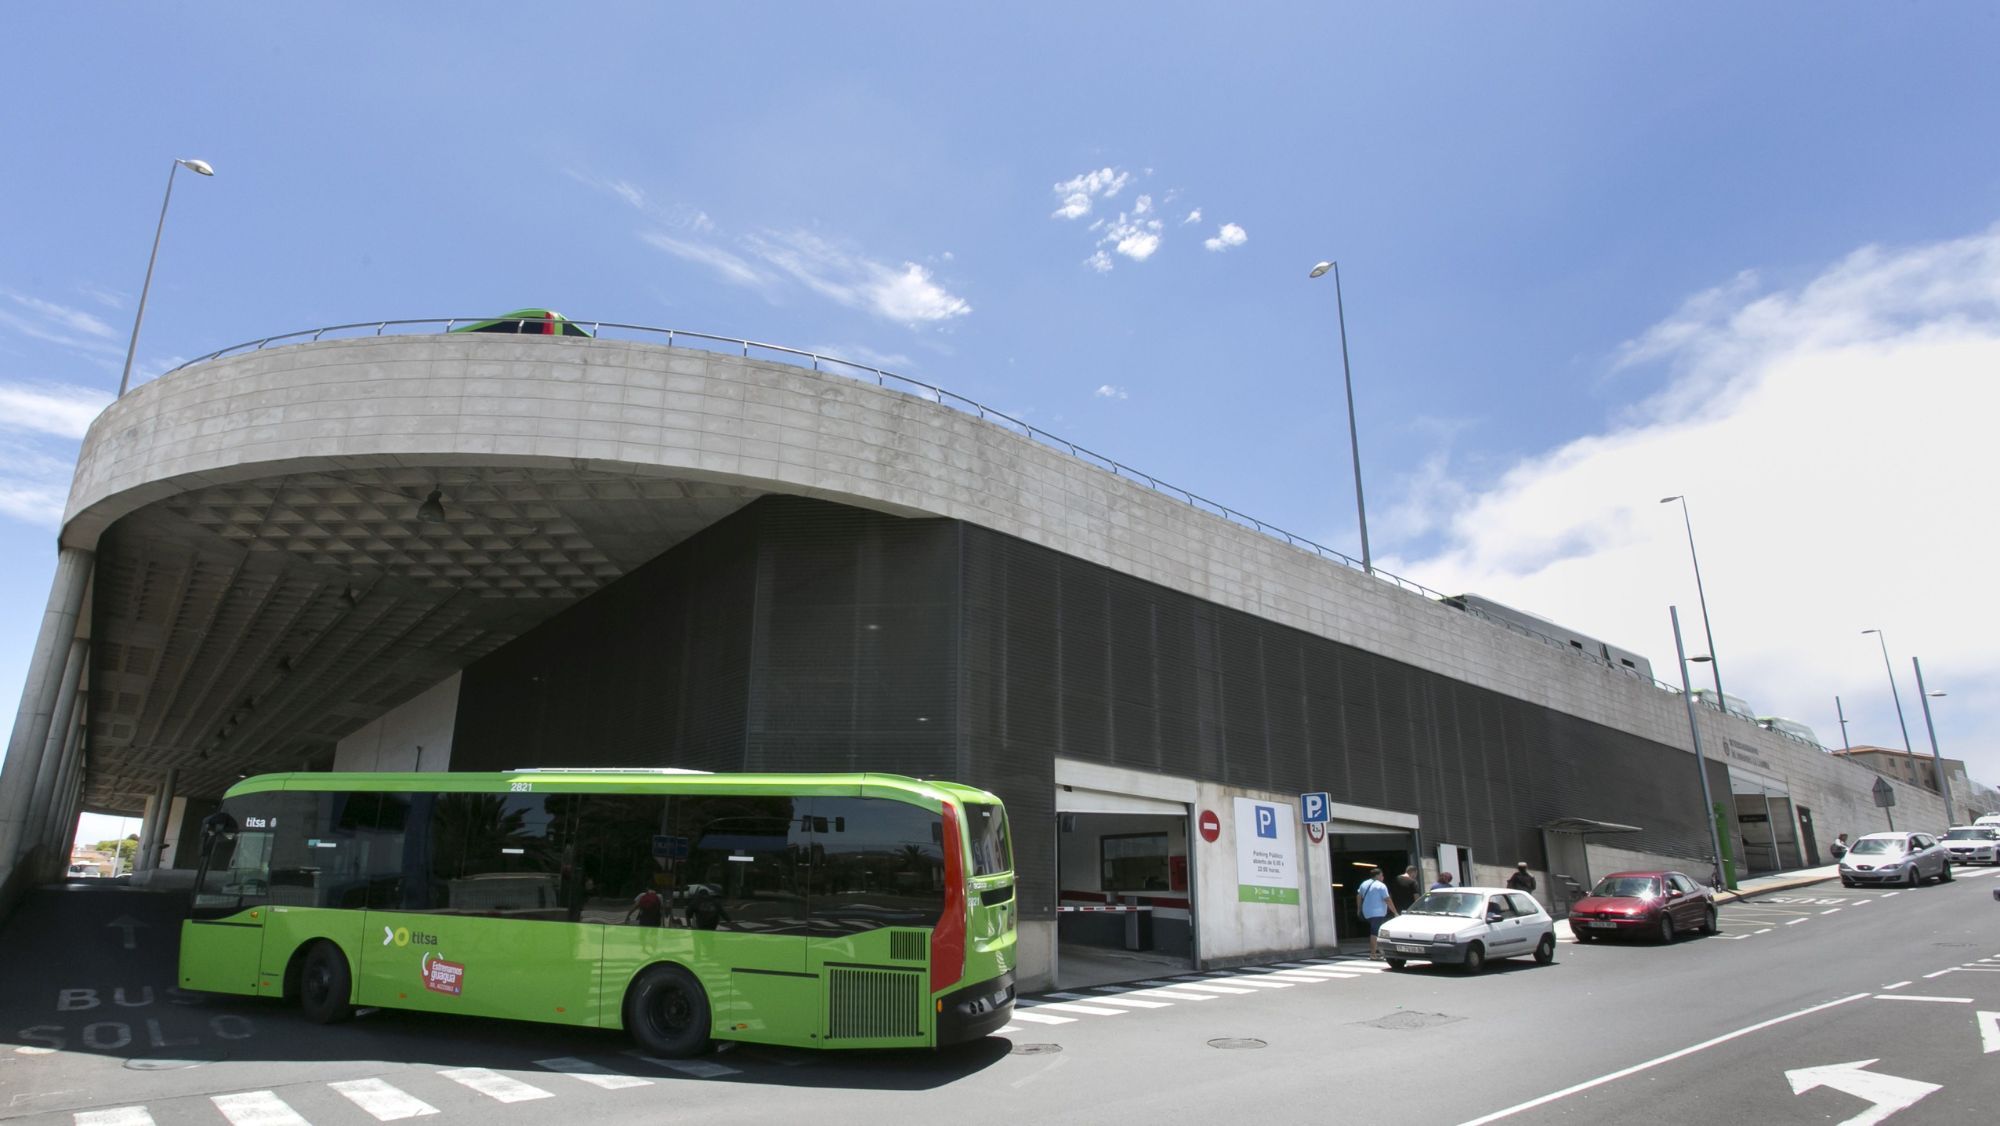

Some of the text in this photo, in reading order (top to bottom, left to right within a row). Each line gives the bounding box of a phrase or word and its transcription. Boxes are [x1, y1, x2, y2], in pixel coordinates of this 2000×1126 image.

[511, 782, 532, 792] 2821
[1306, 796, 1322, 819] P
[245, 817, 266, 828] titsa
[1260, 810, 1271, 834] P
[1253, 850, 1268, 859] Parking
[412, 932, 438, 945] titsa
[430, 970, 457, 984] guagua
[57, 985, 204, 1012] BUS
[14, 1014, 256, 1055] SOLO
